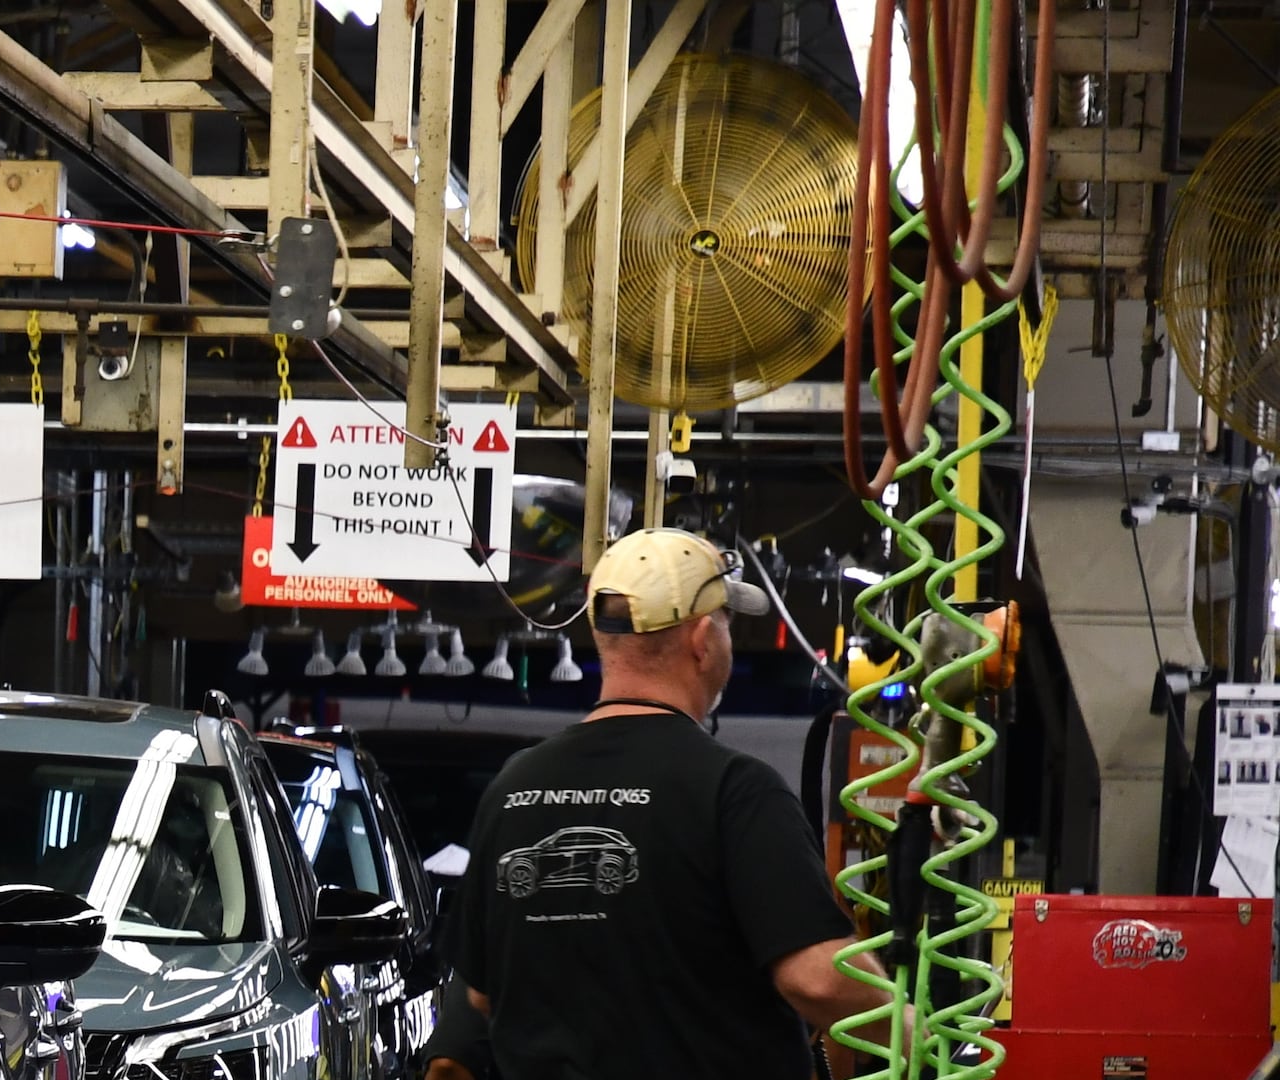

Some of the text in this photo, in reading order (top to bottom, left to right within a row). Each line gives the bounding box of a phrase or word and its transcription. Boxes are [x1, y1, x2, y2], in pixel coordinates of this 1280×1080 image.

[330, 425, 464, 446] ATTENN
[323, 463, 352, 479] DO
[358, 465, 400, 480] NOT
[353, 491, 433, 508] BEYOND
[332, 516, 374, 534] THIS
[381, 519, 441, 536] POINT
[284, 576, 379, 590] AUTHORIZED
[264, 585, 394, 603] PERSONNEL ONLY
[503, 788, 651, 809] 2027 INFINITI QX65
[984, 881, 1040, 896] CAUTION
